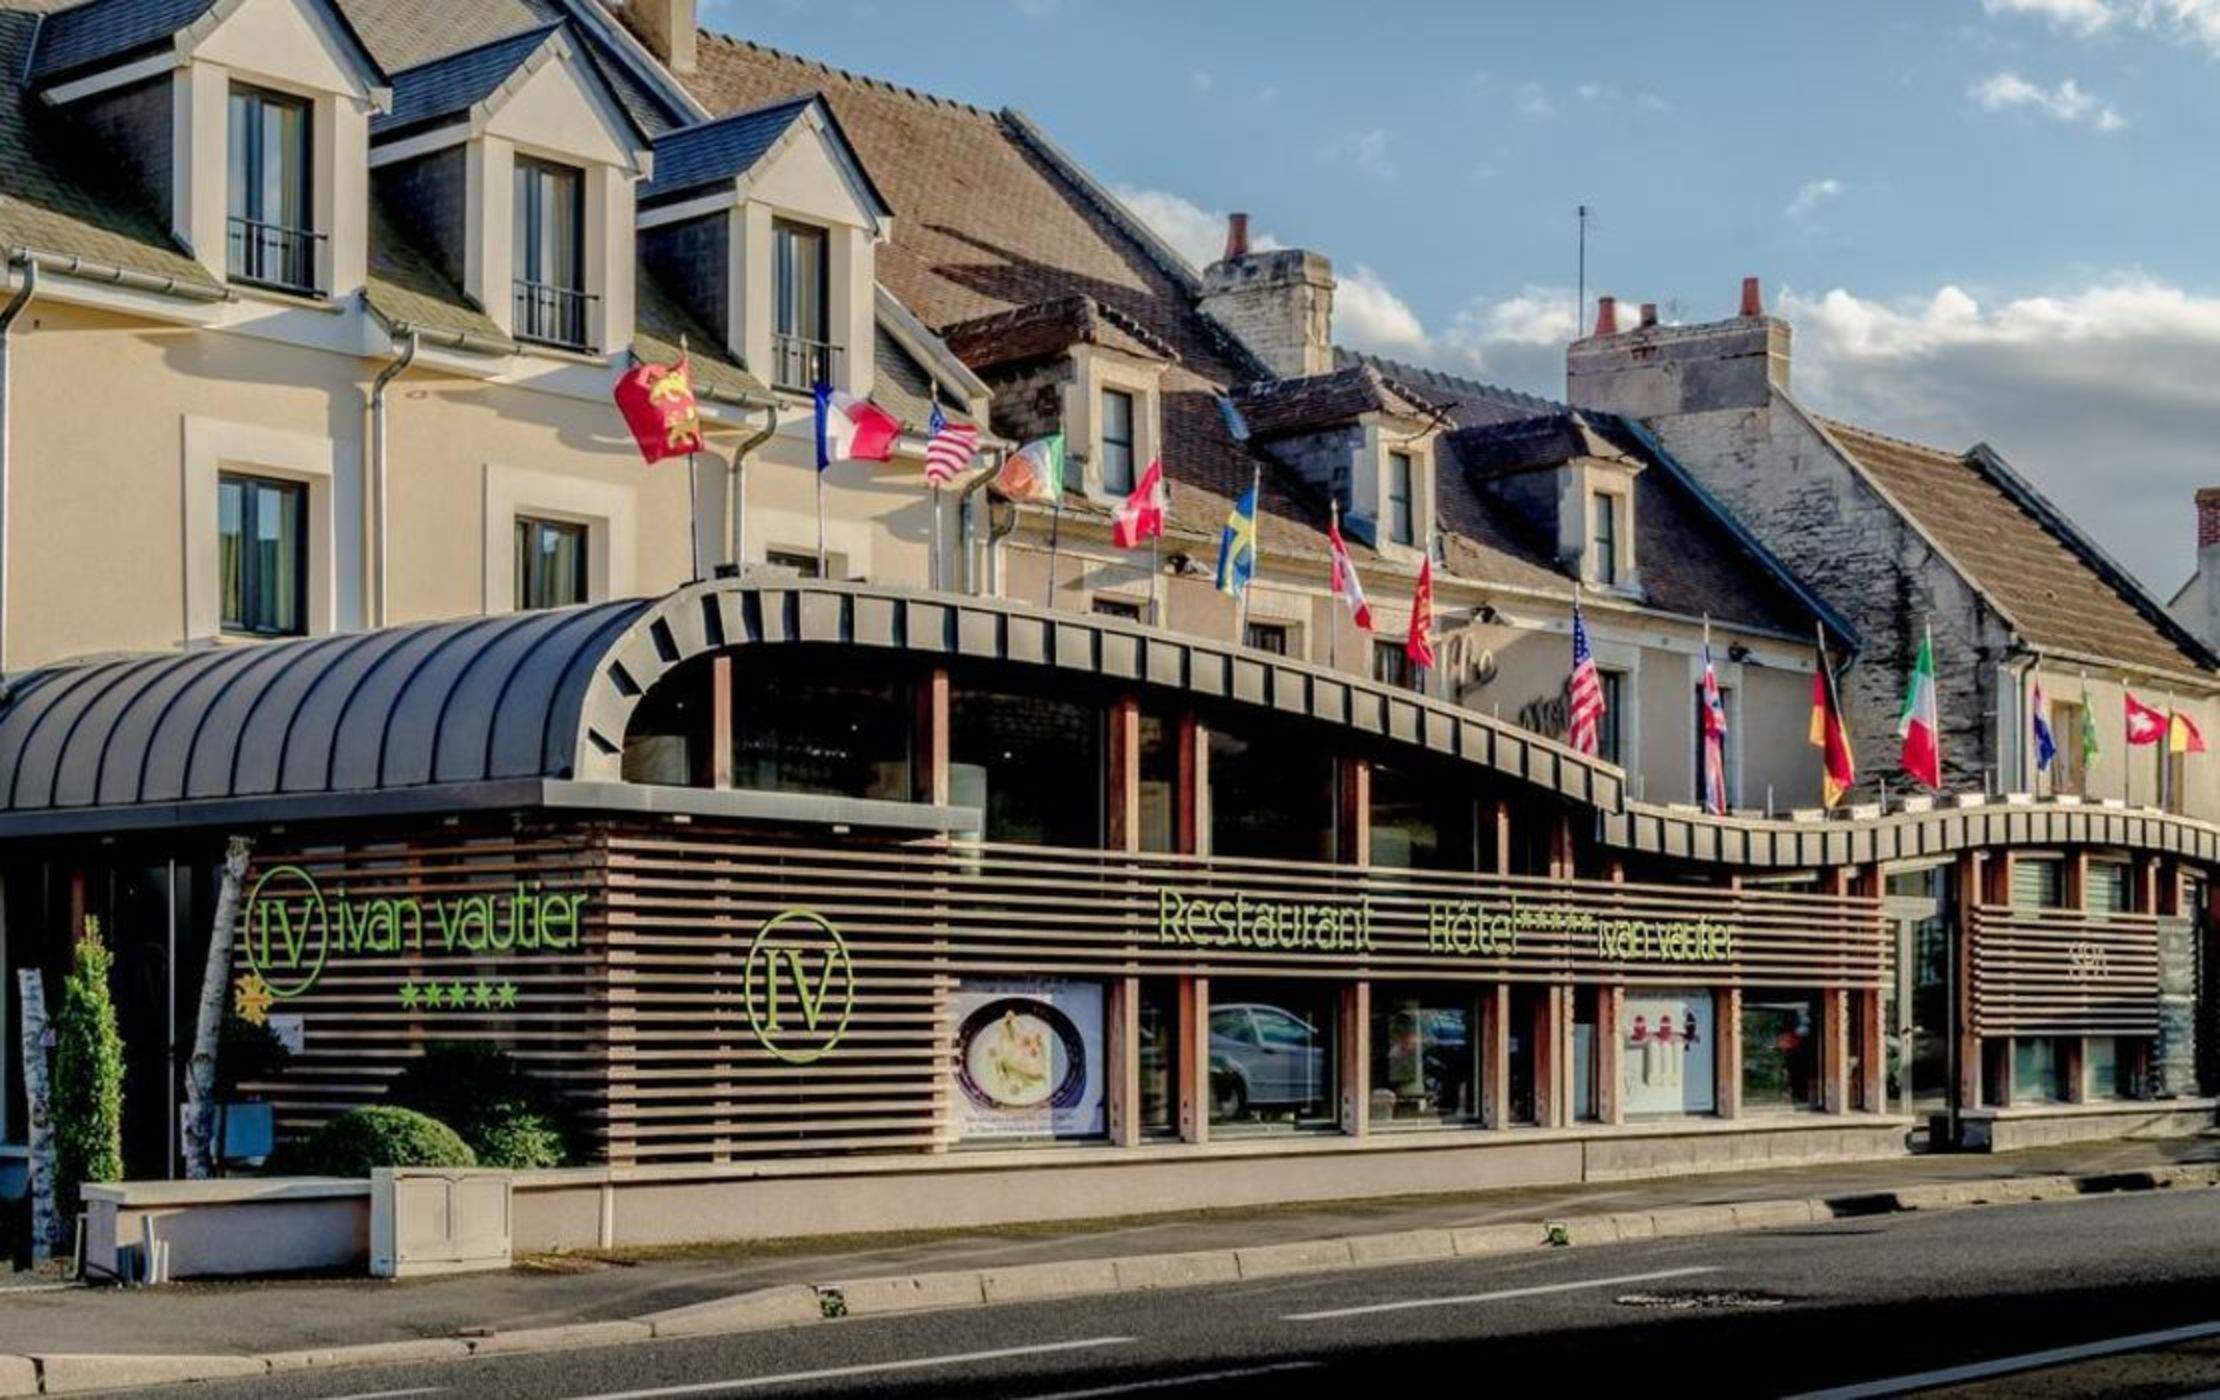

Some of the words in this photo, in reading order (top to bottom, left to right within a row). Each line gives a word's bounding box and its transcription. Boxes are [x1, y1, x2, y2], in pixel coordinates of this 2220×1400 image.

[257, 899, 316, 969] IV
[338, 887, 422, 951] ivan
[437, 881, 587, 950] vautier
[1158, 887, 1375, 950] Restaurant
[1429, 895, 1516, 954] Hôtel
[1656, 914, 1733, 960] vautier
[764, 949, 840, 1033] IV
